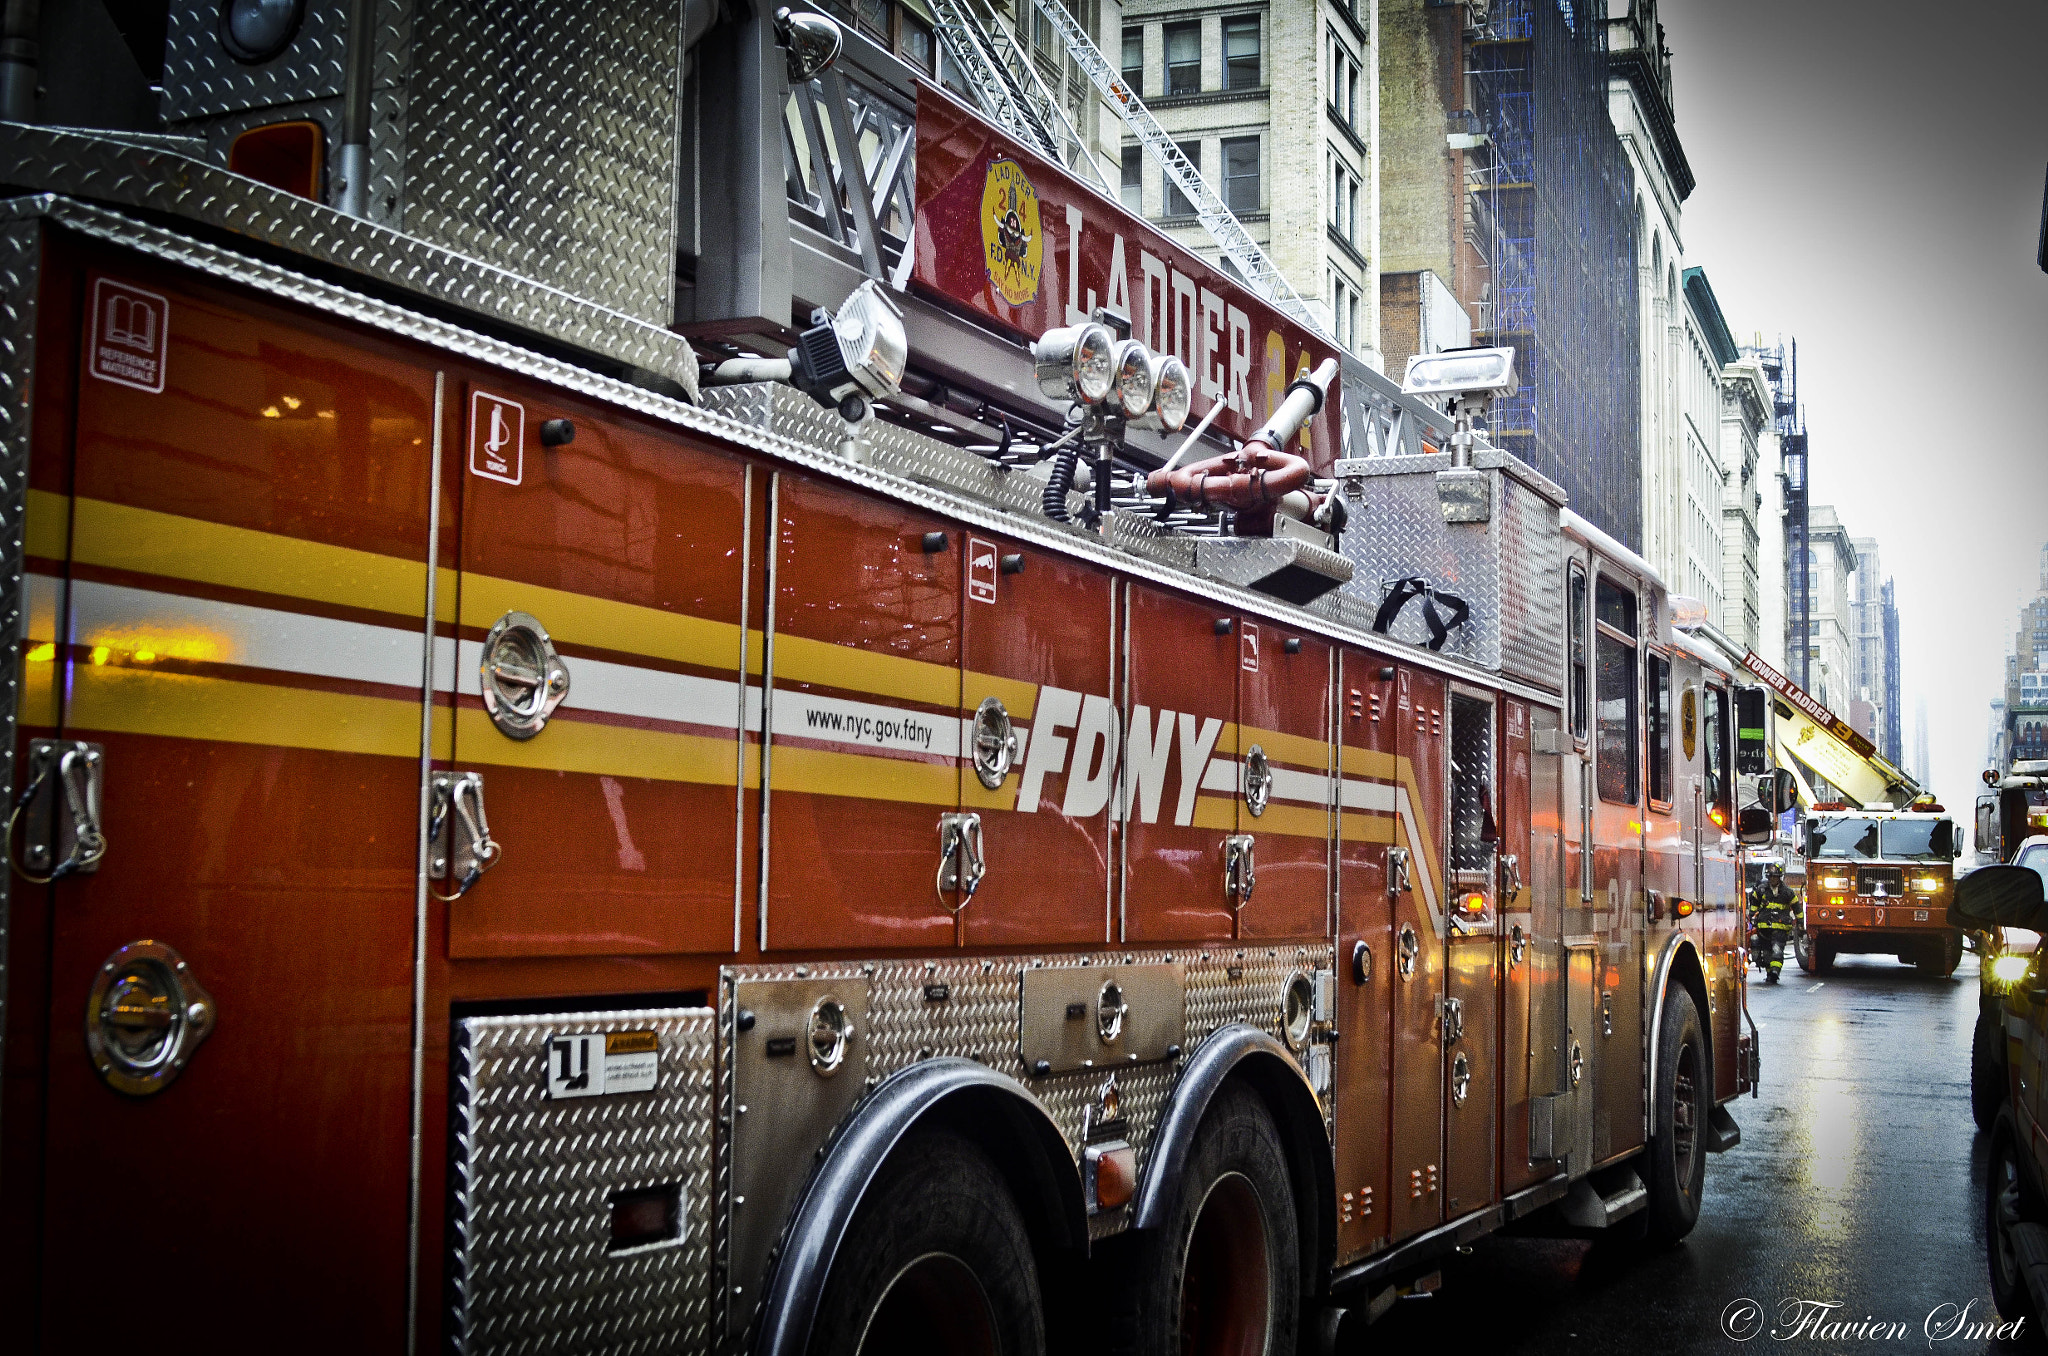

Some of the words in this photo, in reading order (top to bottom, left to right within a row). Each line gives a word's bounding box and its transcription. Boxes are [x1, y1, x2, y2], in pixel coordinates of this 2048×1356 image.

[1065, 203, 1253, 420] LADDER
[806, 709, 932, 749] www.nyc.gov.fdny
[1745, 653, 1788, 691] TOWER
[1785, 687, 1832, 725] LADDER
[1832, 721, 1853, 741] 9
[1016, 685, 1223, 827] FDNY
[1607, 878, 1632, 963] 24
[1876, 908, 1885, 925] 9
